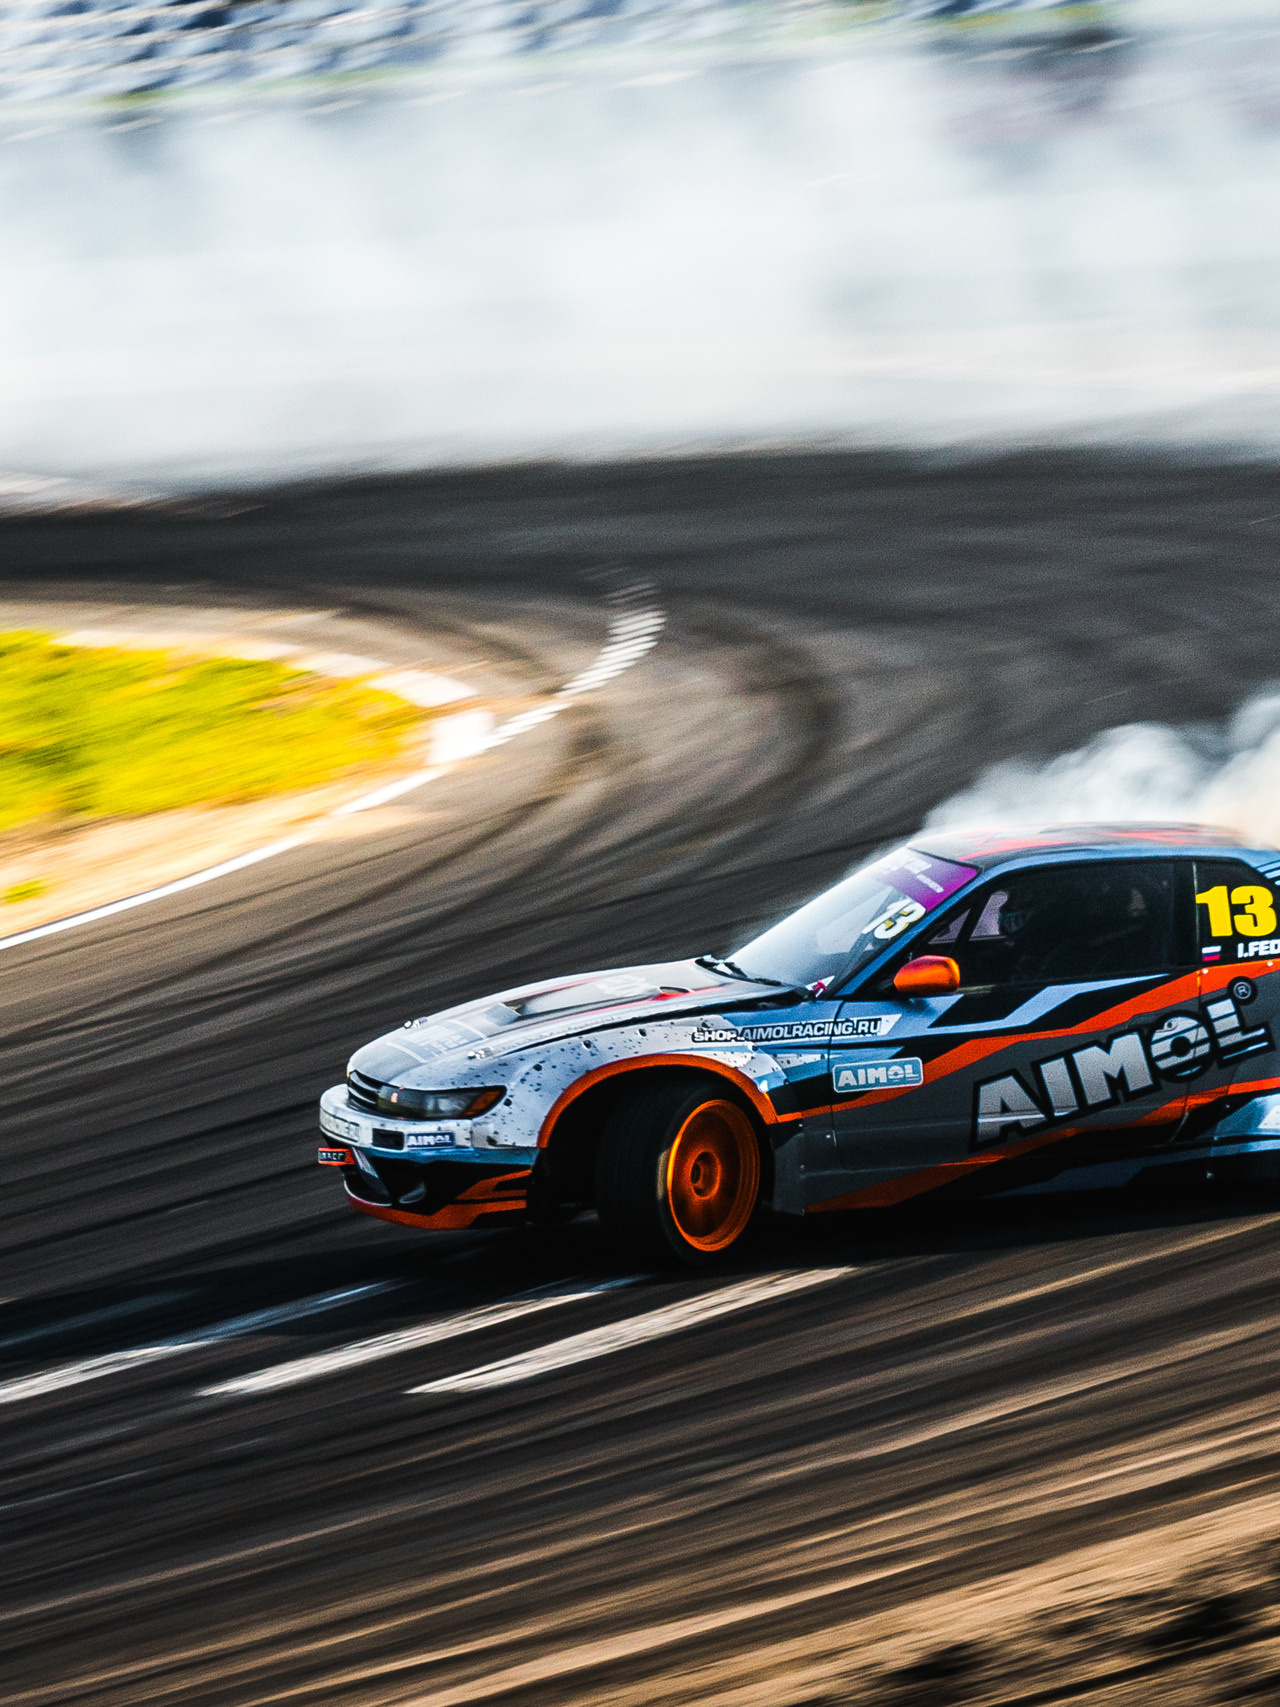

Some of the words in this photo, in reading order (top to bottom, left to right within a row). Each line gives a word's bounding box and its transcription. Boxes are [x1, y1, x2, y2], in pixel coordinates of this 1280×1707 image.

[861, 898, 926, 940] 13
[1195, 885, 1277, 937] 13
[837, 1063, 920, 1088] AIMOL
[407, 1134, 452, 1147] AIMOL
